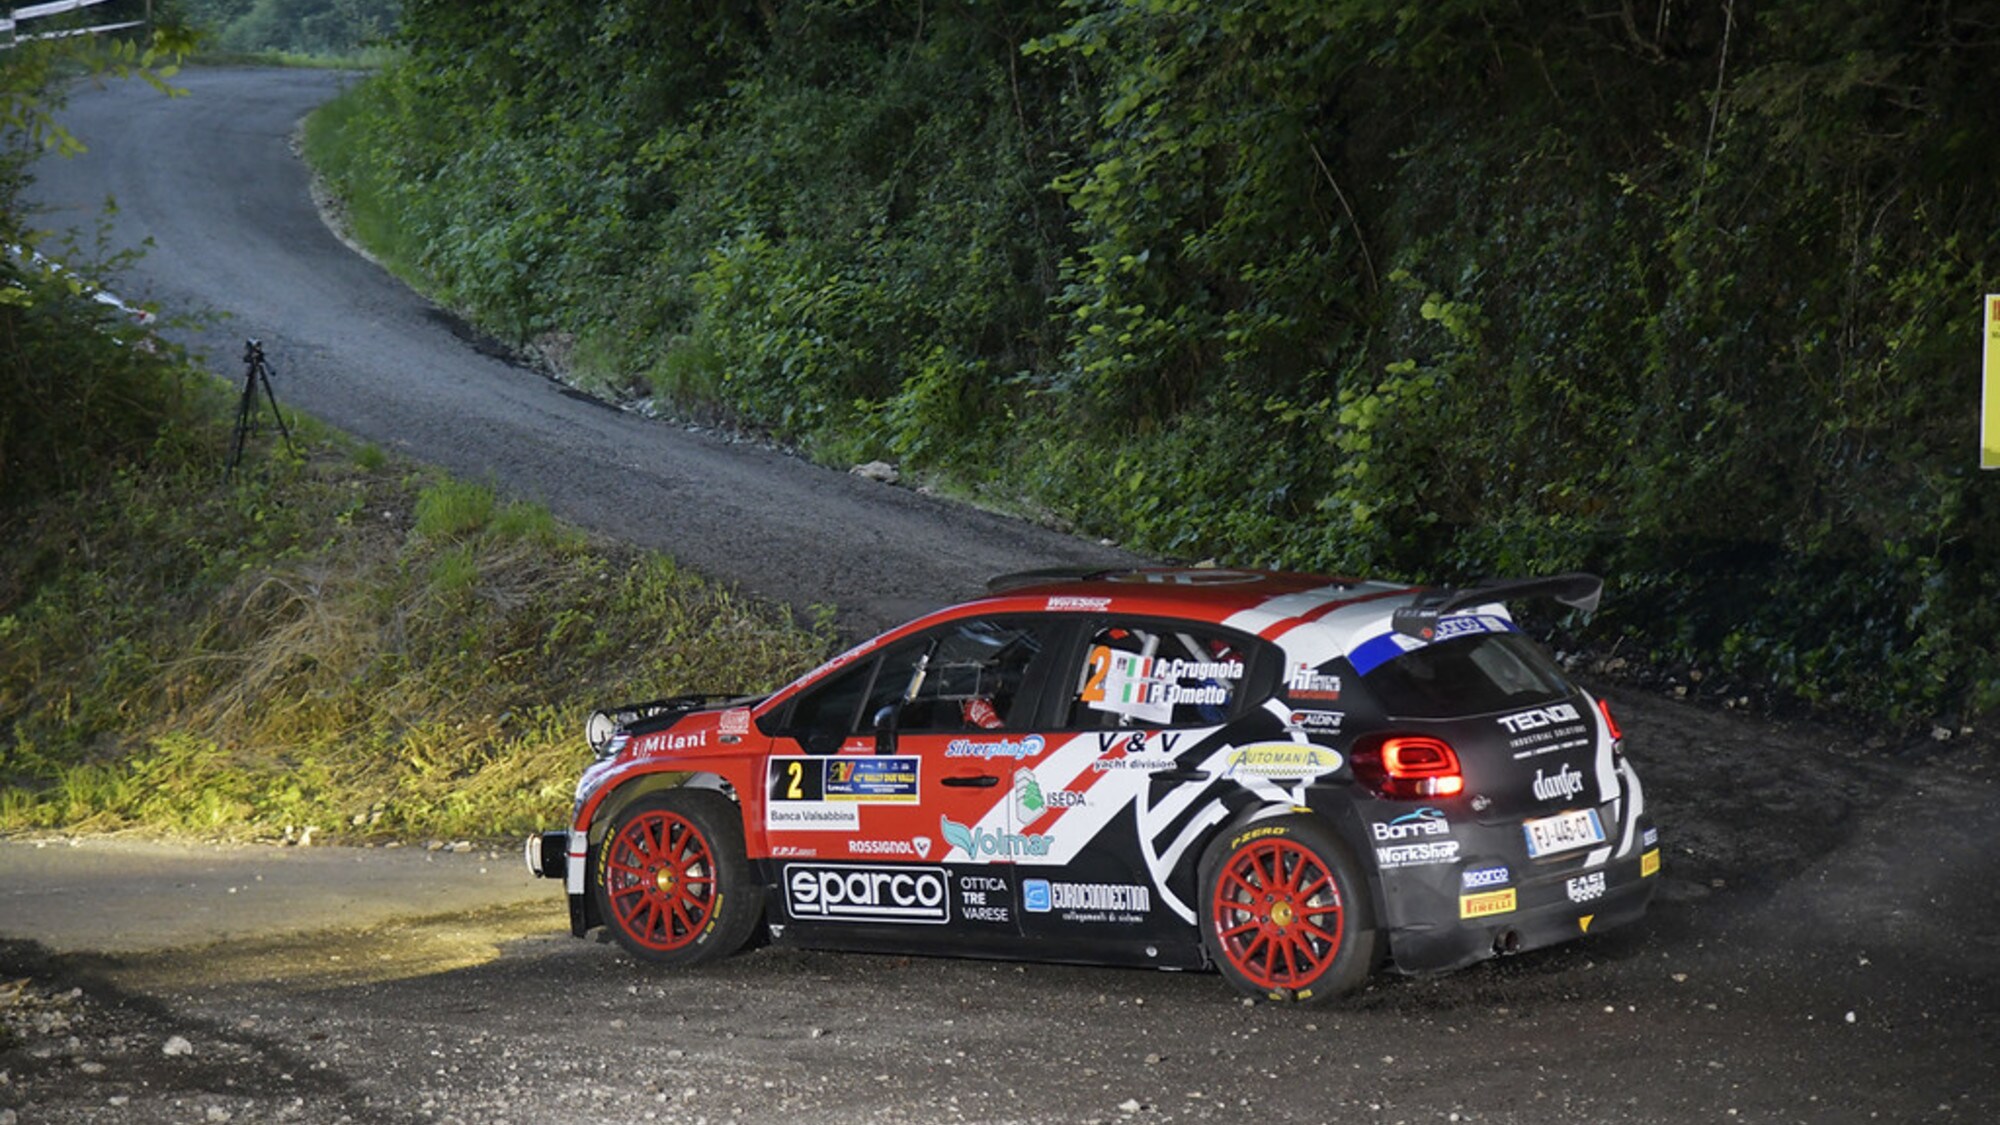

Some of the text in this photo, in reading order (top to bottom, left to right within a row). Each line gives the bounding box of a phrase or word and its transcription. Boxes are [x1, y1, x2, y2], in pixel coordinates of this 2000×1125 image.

[1081, 646, 1111, 702] 2
[644, 730, 707, 752] Milani
[1099, 731, 1181, 752] V & V
[1094, 757, 1177, 770] yacht division
[786, 760, 804, 799] 2
[771, 810, 856, 821] Banca Valsabbina
[848, 840, 915, 854] ROSSIGNOL
[957, 824, 1054, 859] Volmar
[791, 870, 943, 915] sparco
[960, 877, 1008, 891] OTTICA
[963, 892, 987, 905] TRE
[962, 907, 1009, 922] VARESE
